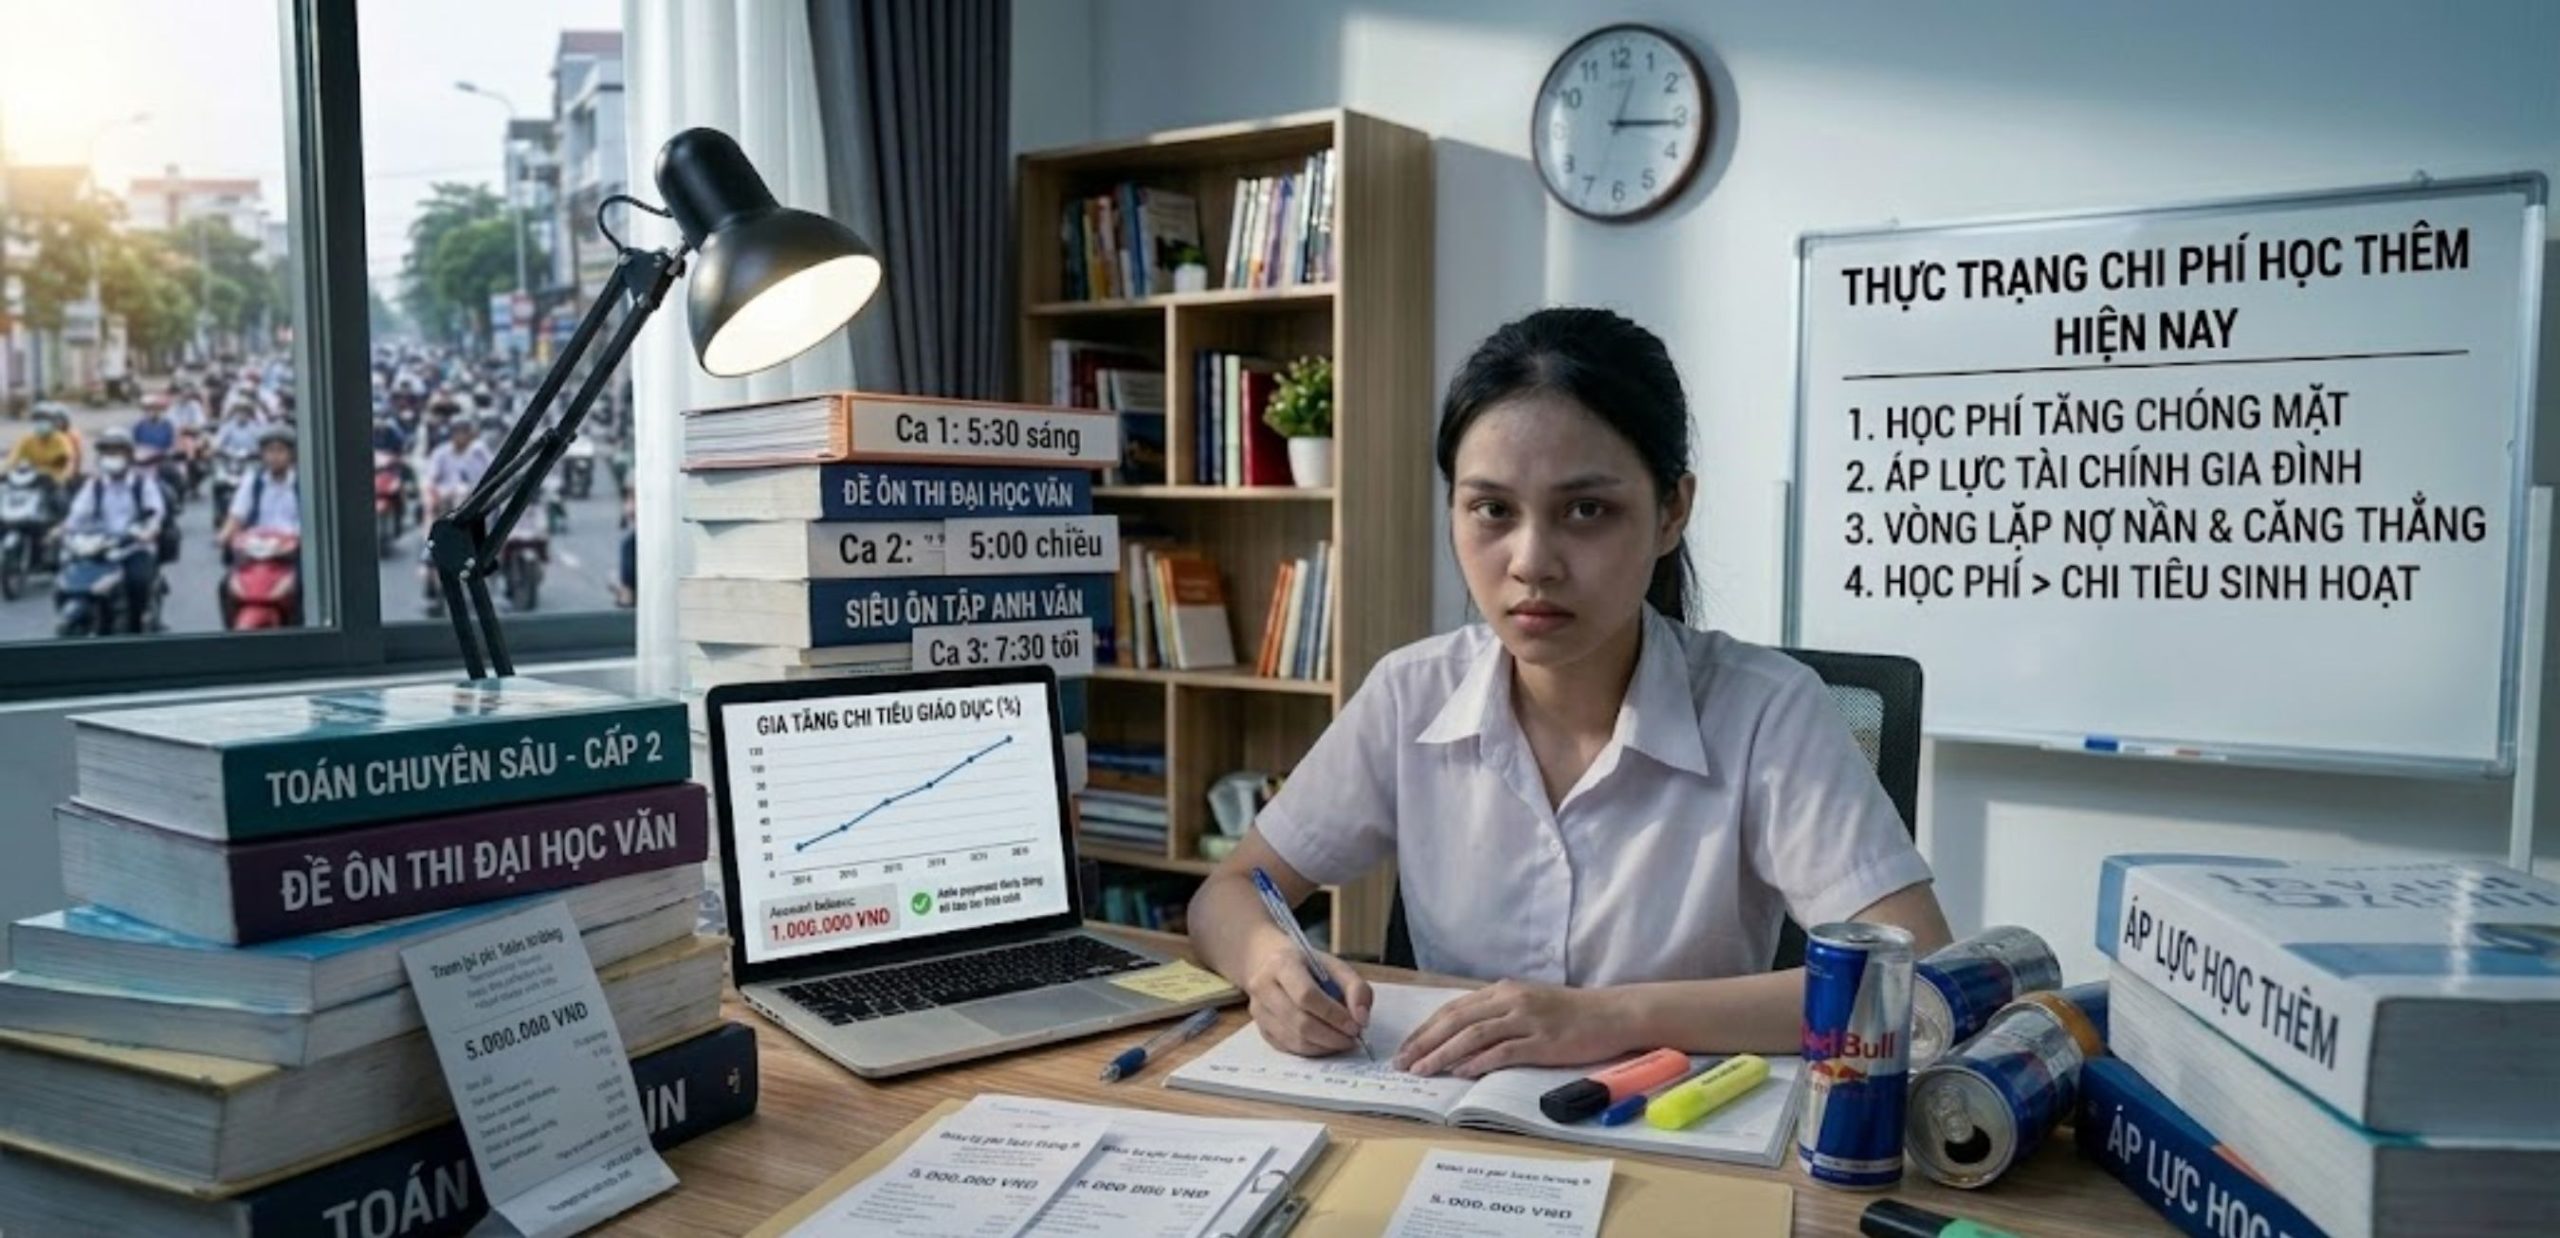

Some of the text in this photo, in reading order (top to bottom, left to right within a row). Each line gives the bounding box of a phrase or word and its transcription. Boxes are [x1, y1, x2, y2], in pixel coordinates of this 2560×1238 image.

[1581, 60, 1598, 82] 11
[1610, 47, 1631, 69] 12
[1646, 53, 1654, 71] 1
[1561, 87, 1582, 109] 10
[1664, 72, 1679, 93] 2
[1664, 141, 1678, 160] 4
[1582, 176, 1596, 195] 7
[1612, 180, 1625, 201] 6
[1642, 169, 1655, 190] 5
[1841, 219, 2470, 312] THỰC TRẠNG CHI PHÍ HỌC THÊM
[2055, 304, 2239, 363] HIỆN NAY
[1848, 382, 2349, 446] 1. HỌC PHÍ TĂNG CHÓNG MẶT
[896, 413, 1081, 456] Ca 1: 5:30 sáng
[1846, 440, 2362, 498] 2. ÁP LỰC TÀI CHÍNH GIA ĐÌNH
[843, 472, 872, 506] ĐỀ
[876, 474, 909, 506] ÔN
[912, 480, 946, 506] THI
[951, 482, 984, 511] ĐẠI
[990, 482, 1030, 512] HỌC
[1845, 490, 2487, 551] 3. VÒNG LẶP NỢ NẦN & CĂNG THẲNG
[839, 532, 913, 564] Ca 2:
[970, 530, 1028, 560] 5:00
[1844, 555, 2421, 608] 4. HỌC PHÍ > CHI TIÊU SINH HOẠT
[846, 592, 899, 628] SIÊU
[991, 591, 1037, 620] ANH
[929, 639, 960, 667] Ca
[966, 637, 989, 664] 3:
[995, 633, 1044, 662] 7:30
[756, 714, 788, 736] GIA
[843, 707, 872, 729] CHI
[265, 758, 356, 807] TOÁN
[365, 743, 492, 796] CHUYÊN
[499, 737, 557, 780] SÂU
[584, 723, 639, 770] CẤP
[645, 730, 662, 763] 2
[280, 807, 677, 912] ĐỀ ÔN THI ĐẠI HỌC VĂN
[2123, 895, 2340, 1071] ÁP LỰC HỌC THÊM
[464, 1013, 551, 1062] 5.000.000
[1844, 1031, 1897, 1059] Bull
[2106, 1104, 2143, 1165] ÁP
[2146, 1139, 2201, 1215] LỰC
[322, 1158, 470, 1238] TOÁN
